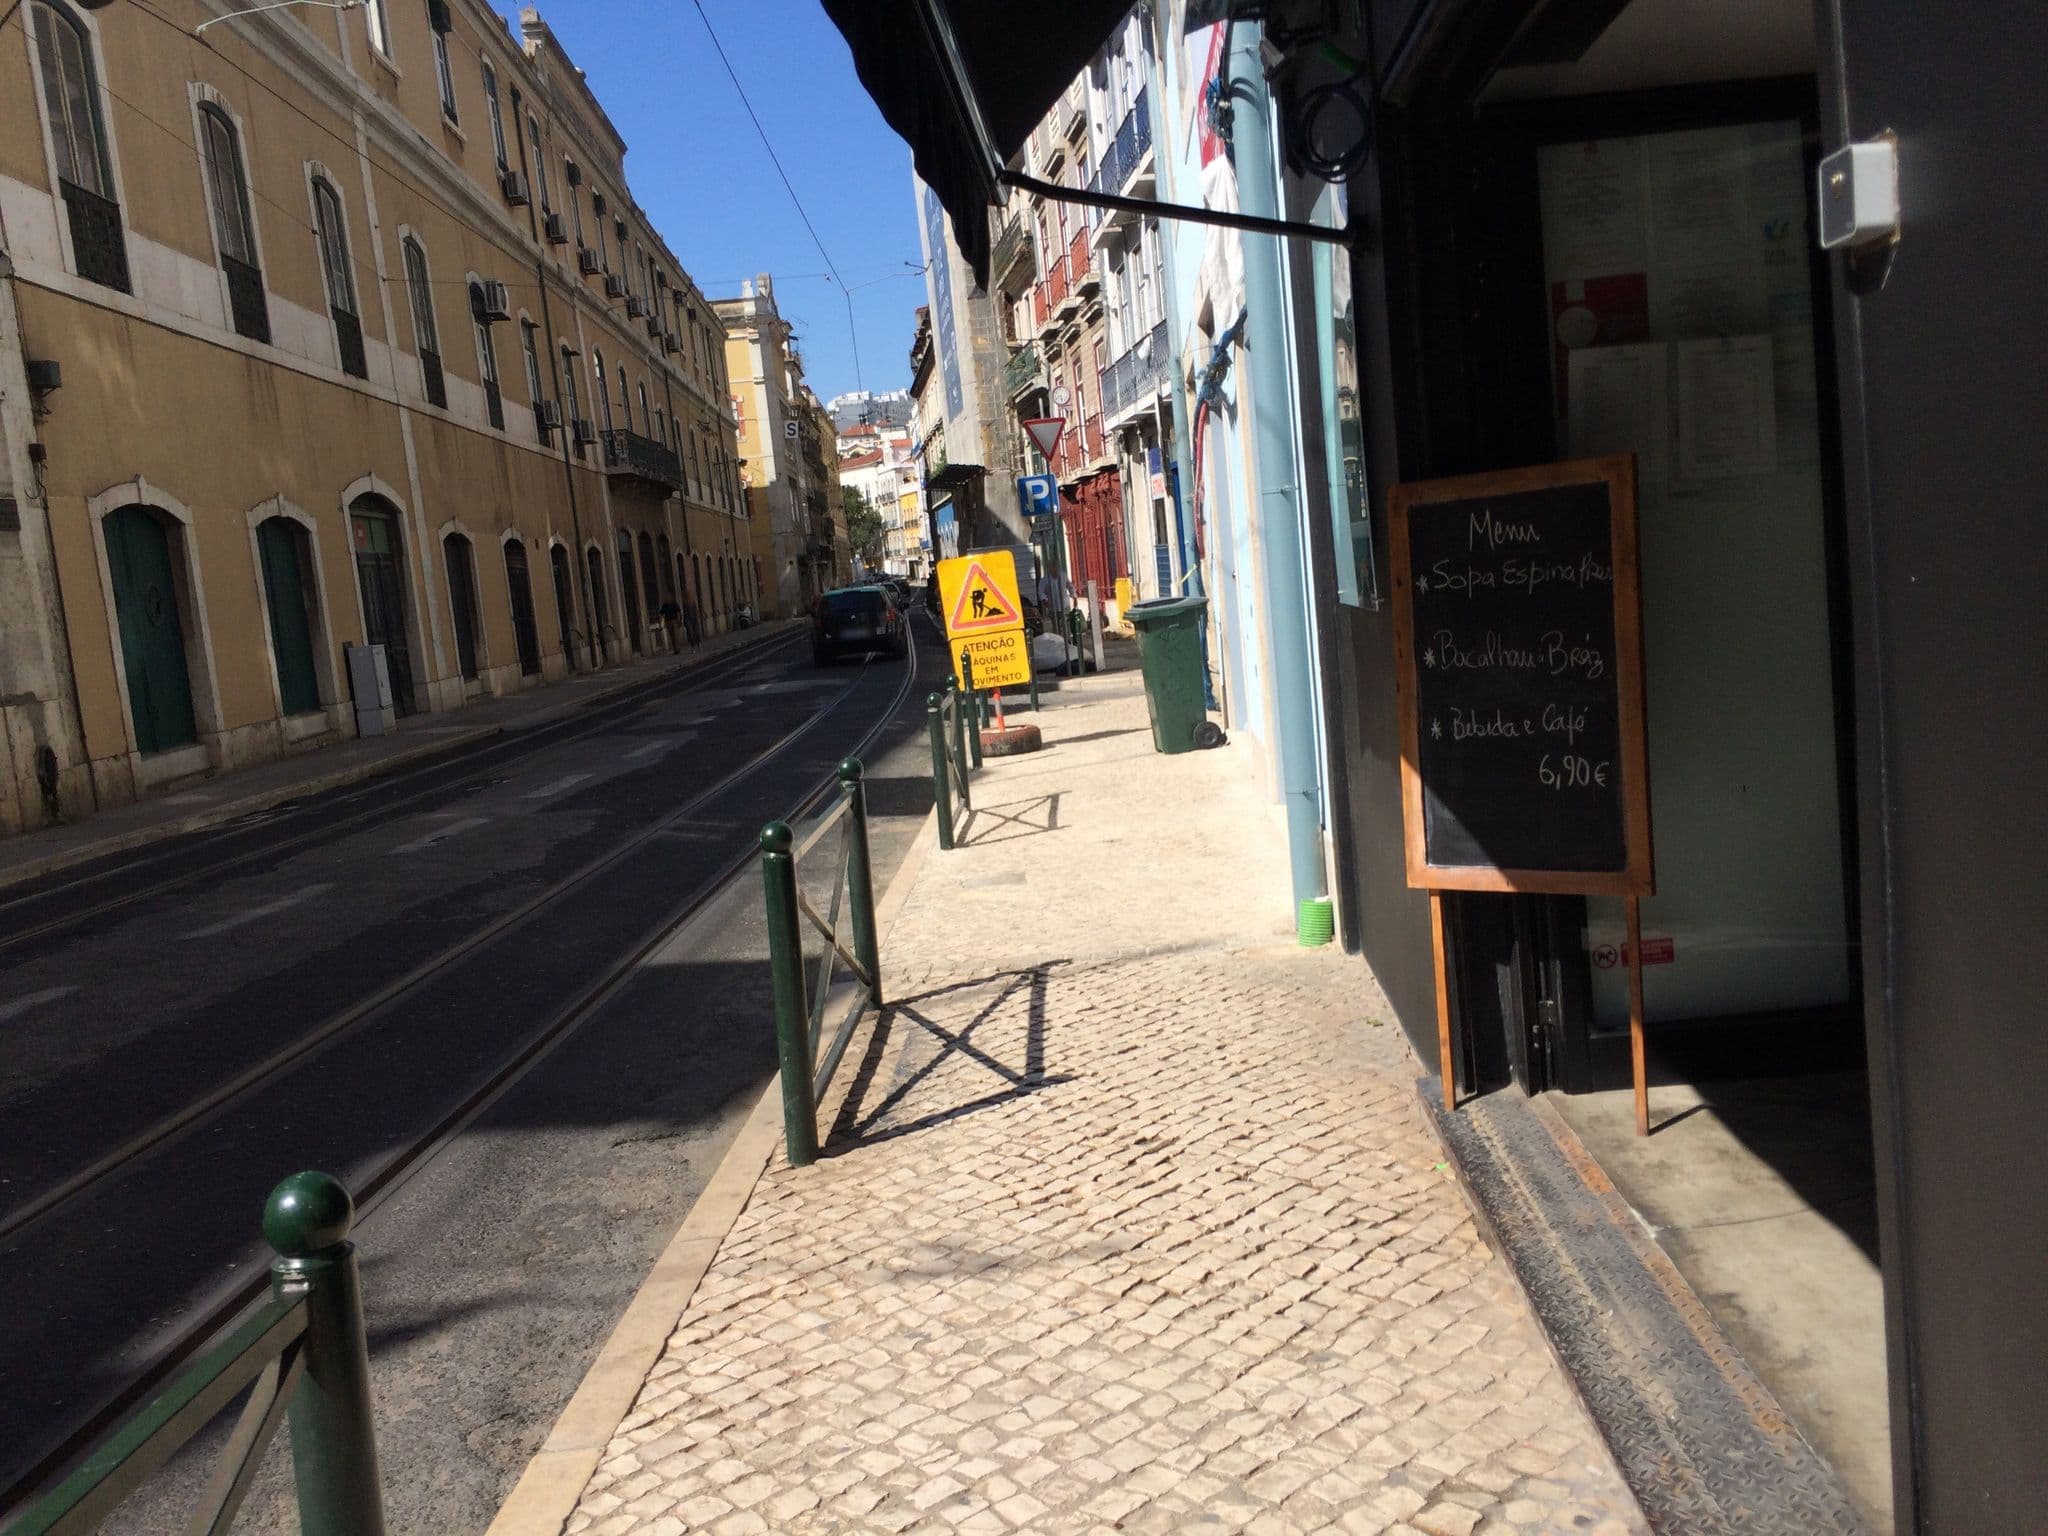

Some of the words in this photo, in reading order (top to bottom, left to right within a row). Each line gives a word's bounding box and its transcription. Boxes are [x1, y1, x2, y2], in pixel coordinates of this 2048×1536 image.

[787, 422, 796, 436] S
[1025, 479, 1050, 513] P
[1468, 508, 1541, 552] Menu
[1432, 558, 1496, 599] Sopa
[963, 636, 1015, 653] ATENÇÃO
[974, 672, 1023, 686] OVIMENTO
[985, 665, 999, 675] EM
[1449, 706, 1520, 741] Bebida
[1541, 703, 1590, 746] Café
